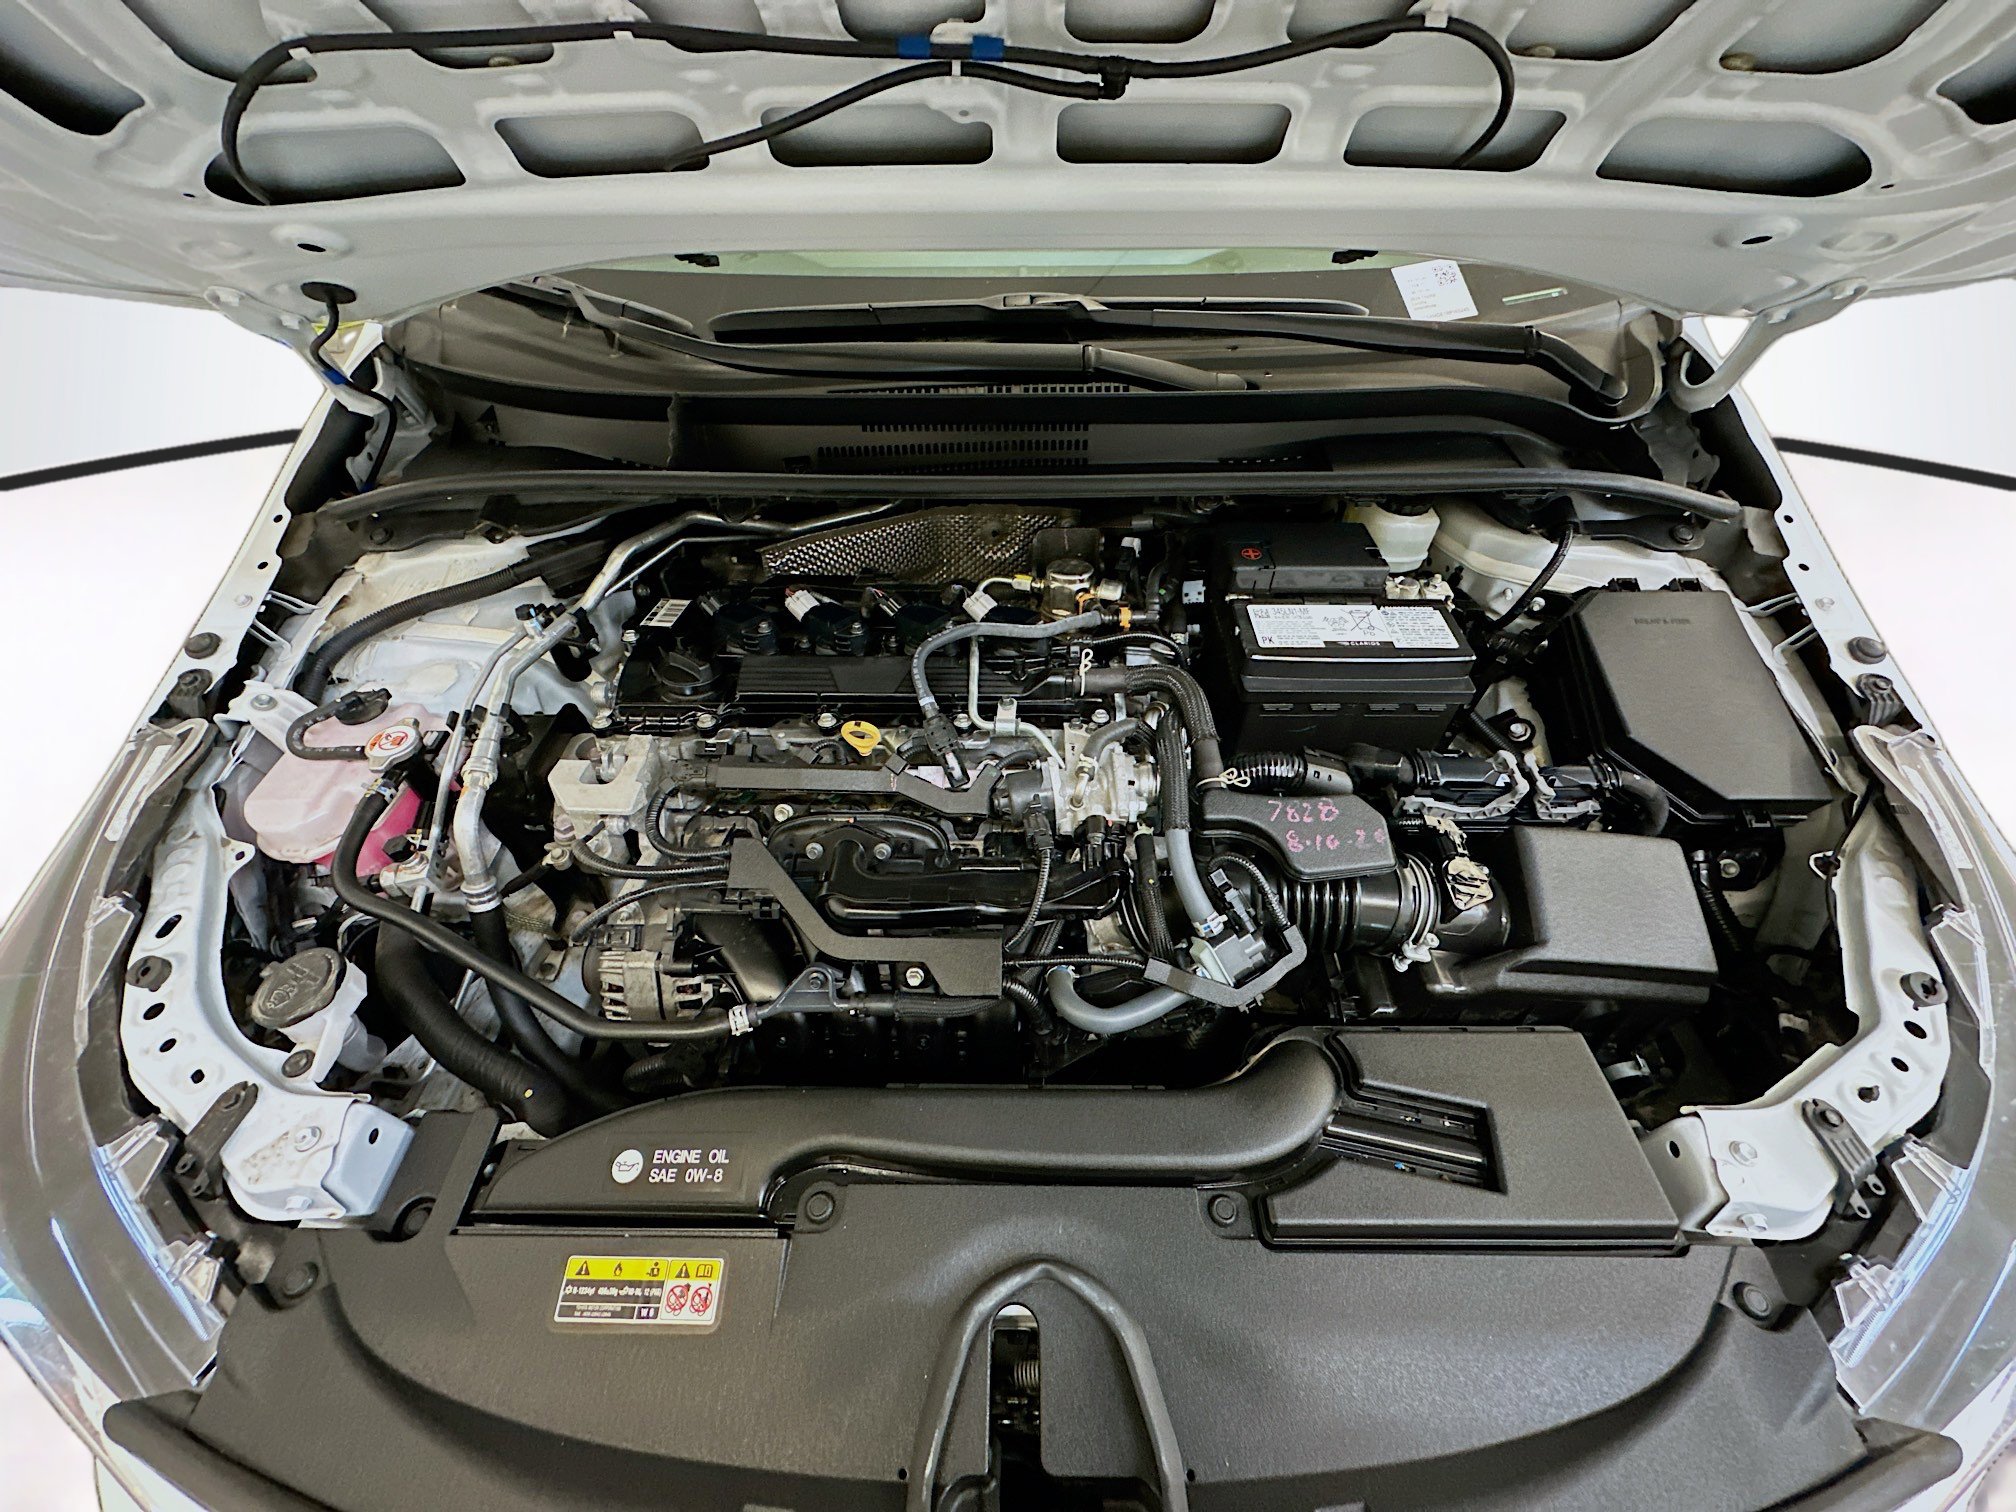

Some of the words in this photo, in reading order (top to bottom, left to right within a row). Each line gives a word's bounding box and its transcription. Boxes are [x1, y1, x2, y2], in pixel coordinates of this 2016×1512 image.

[1261, 635, 1275, 645] PK
[653, 1149, 701, 1164] ENGINE
[708, 1149, 730, 1164] OIL
[648, 1168, 678, 1183] SAE
[685, 1168, 723, 1183] 0W-8
